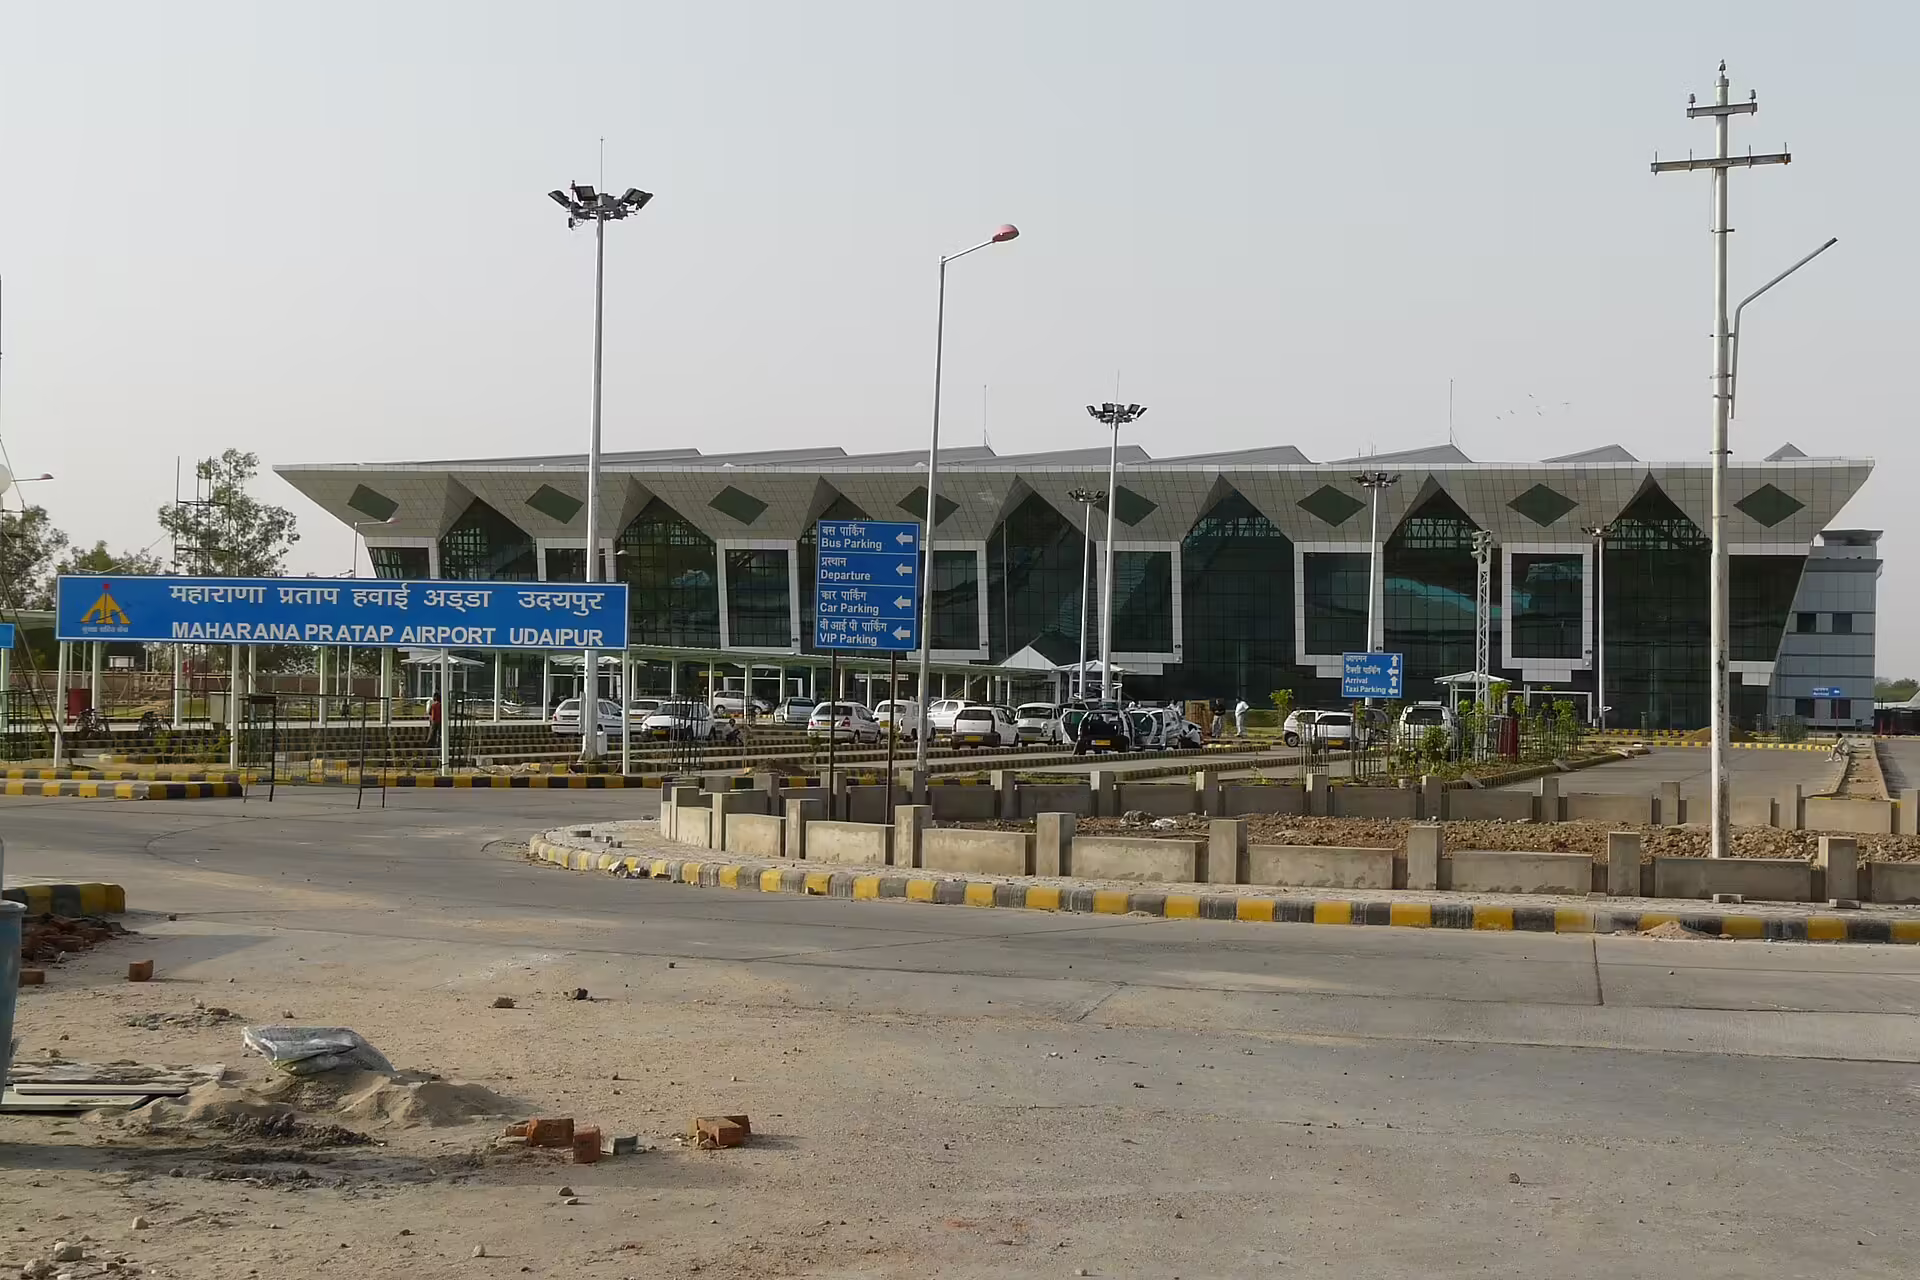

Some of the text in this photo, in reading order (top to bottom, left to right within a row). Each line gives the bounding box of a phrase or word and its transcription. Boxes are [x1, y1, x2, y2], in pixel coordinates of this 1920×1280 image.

[822, 526, 836, 536] बस
[821, 538, 882, 551] Bus Parking
[821, 570, 870, 581] Departure
[169, 583, 604, 616] महाराणा प्रताप हवाई अड्डा उदयपुर
[821, 591, 837, 600] कार
[820, 603, 879, 615] Car Parking
[172, 622, 603, 646] MAHARANA PRATAP AIRPORT UDAIPUR
[820, 633, 877, 646] VIP Parking
[1360, 686, 1386, 694] Parking
